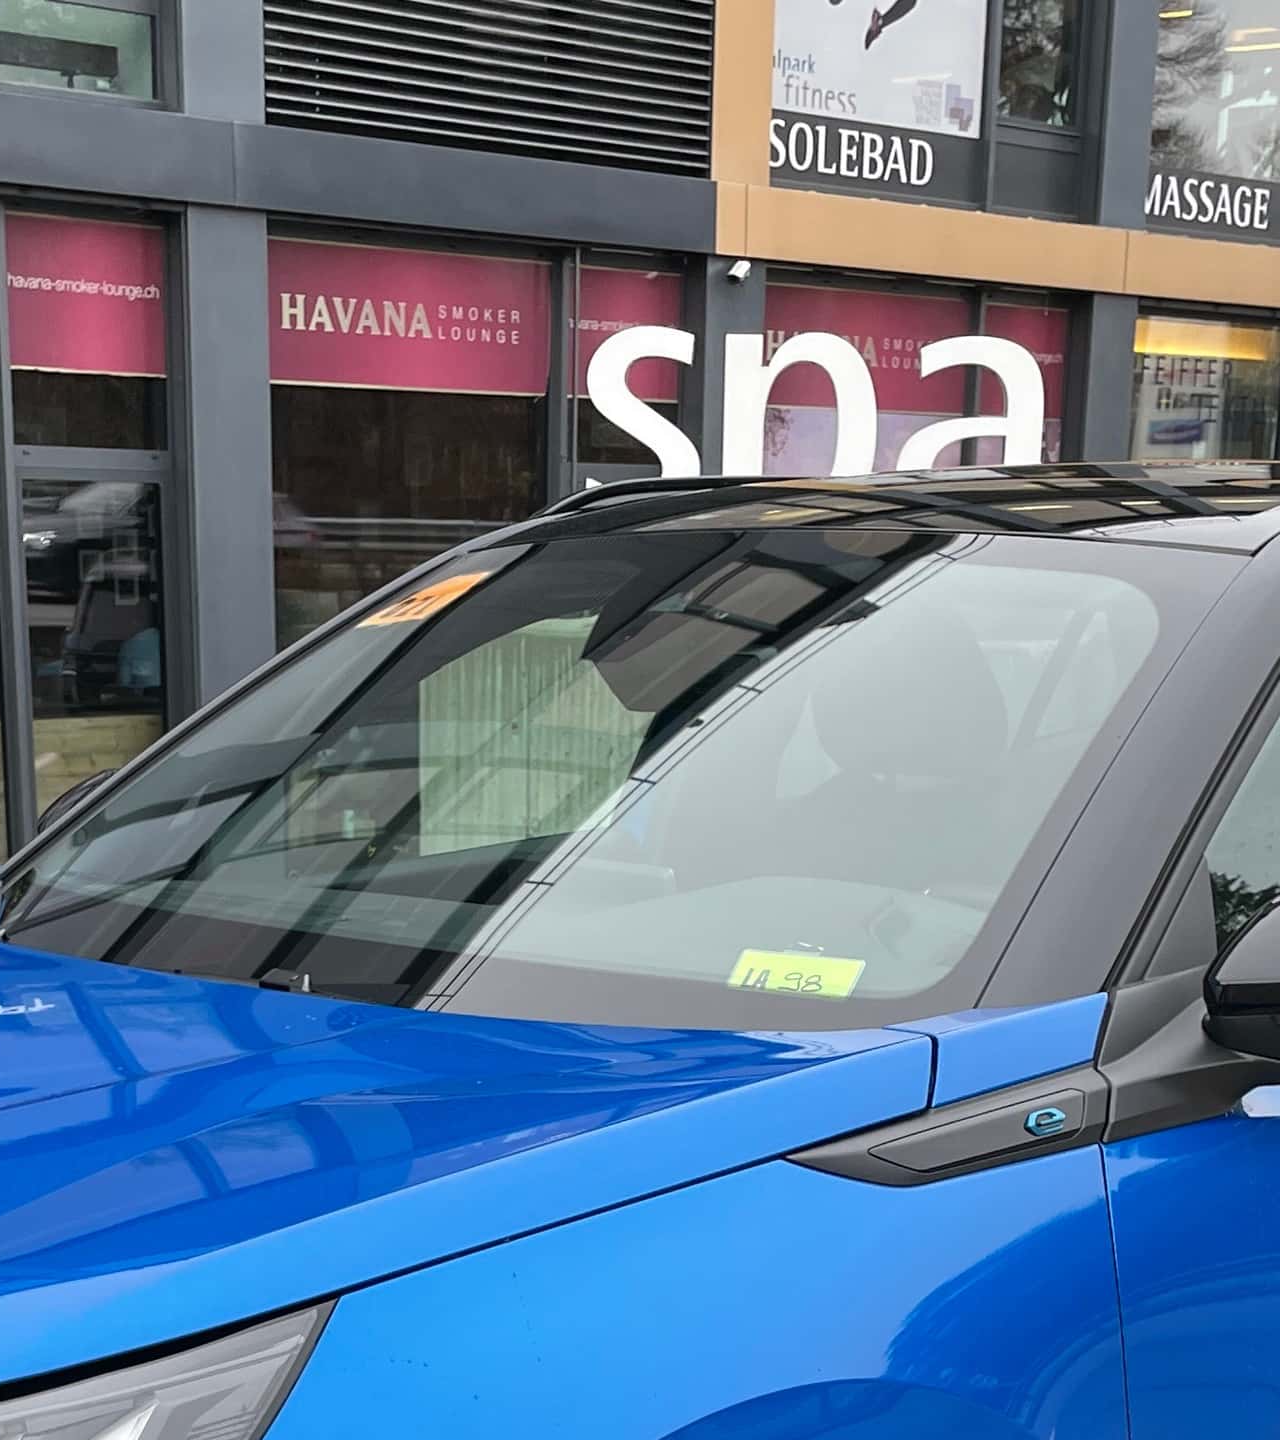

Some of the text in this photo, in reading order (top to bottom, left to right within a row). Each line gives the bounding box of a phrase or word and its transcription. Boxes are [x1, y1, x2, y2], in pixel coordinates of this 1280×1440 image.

[784, 75, 857, 114] fitness
[769, 118, 934, 186] SOLEBAD
[1144, 174, 1270, 230] MASSAGE
[7, 272, 160, 301] havana-smoker-lounge.ch
[280, 292, 521, 339] HAVANA SMOKER
[438, 326, 521, 345] LOUNGE
